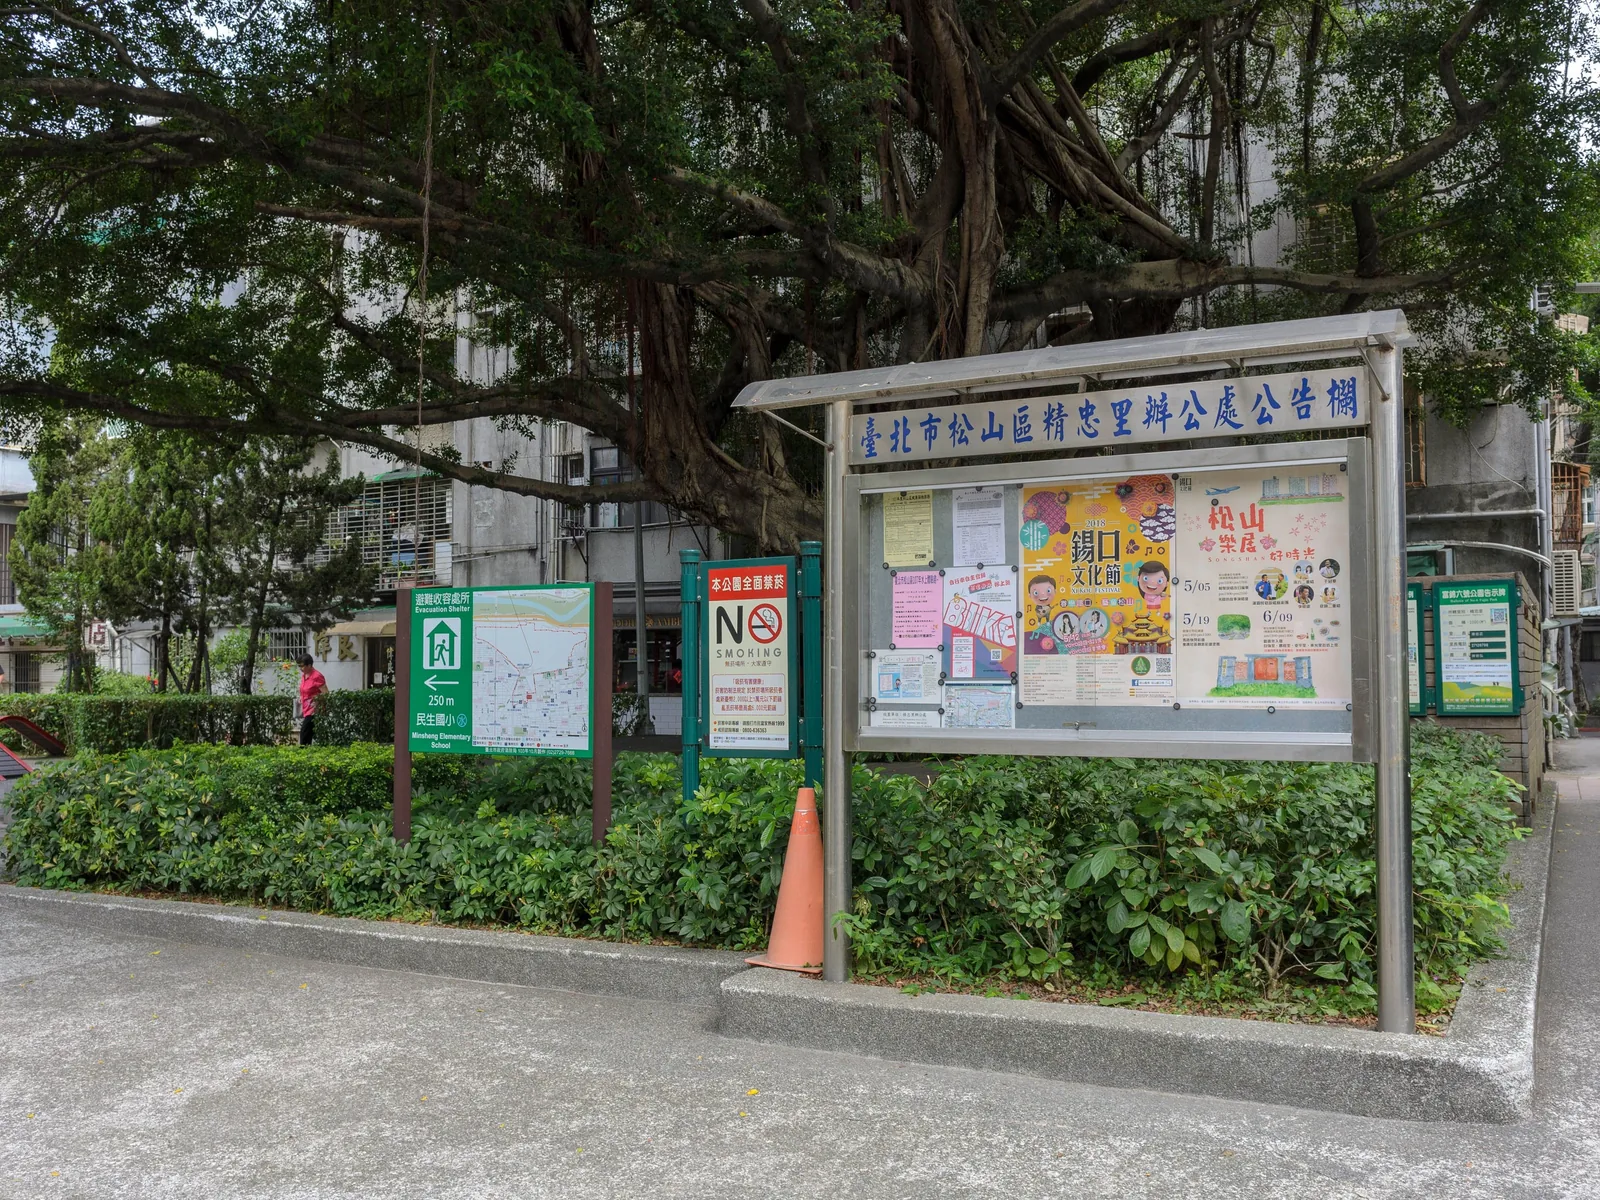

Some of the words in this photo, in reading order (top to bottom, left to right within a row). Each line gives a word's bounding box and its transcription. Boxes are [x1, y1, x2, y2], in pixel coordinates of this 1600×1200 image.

[861, 375, 1358, 458] 臺北市松山區精忠里辦公處公告欄
[1086, 519, 1106, 527] 2018
[1208, 503, 1264, 532] 松山
[1071, 530, 1120, 564] 錫口
[1219, 532, 1257, 553] 樂居
[1270, 547, 1315, 561] 好時光
[1071, 564, 1121, 586] 文化節
[711, 574, 784, 592] 本公園全面禁菸
[1184, 580, 1211, 593] 5/05
[415, 591, 470, 605] 避難收容處所
[943, 597, 1016, 647] BIKE
[1183, 613, 1210, 627] 5/19
[1263, 610, 1293, 624] 6/09
[716, 648, 782, 658] SMOKING
[428, 695, 445, 706] 250
[446, 697, 455, 706] m
[416, 713, 455, 726] 民生國小
[411, 732, 438, 740] Minsheng
[439, 733, 471, 742] Elementary
